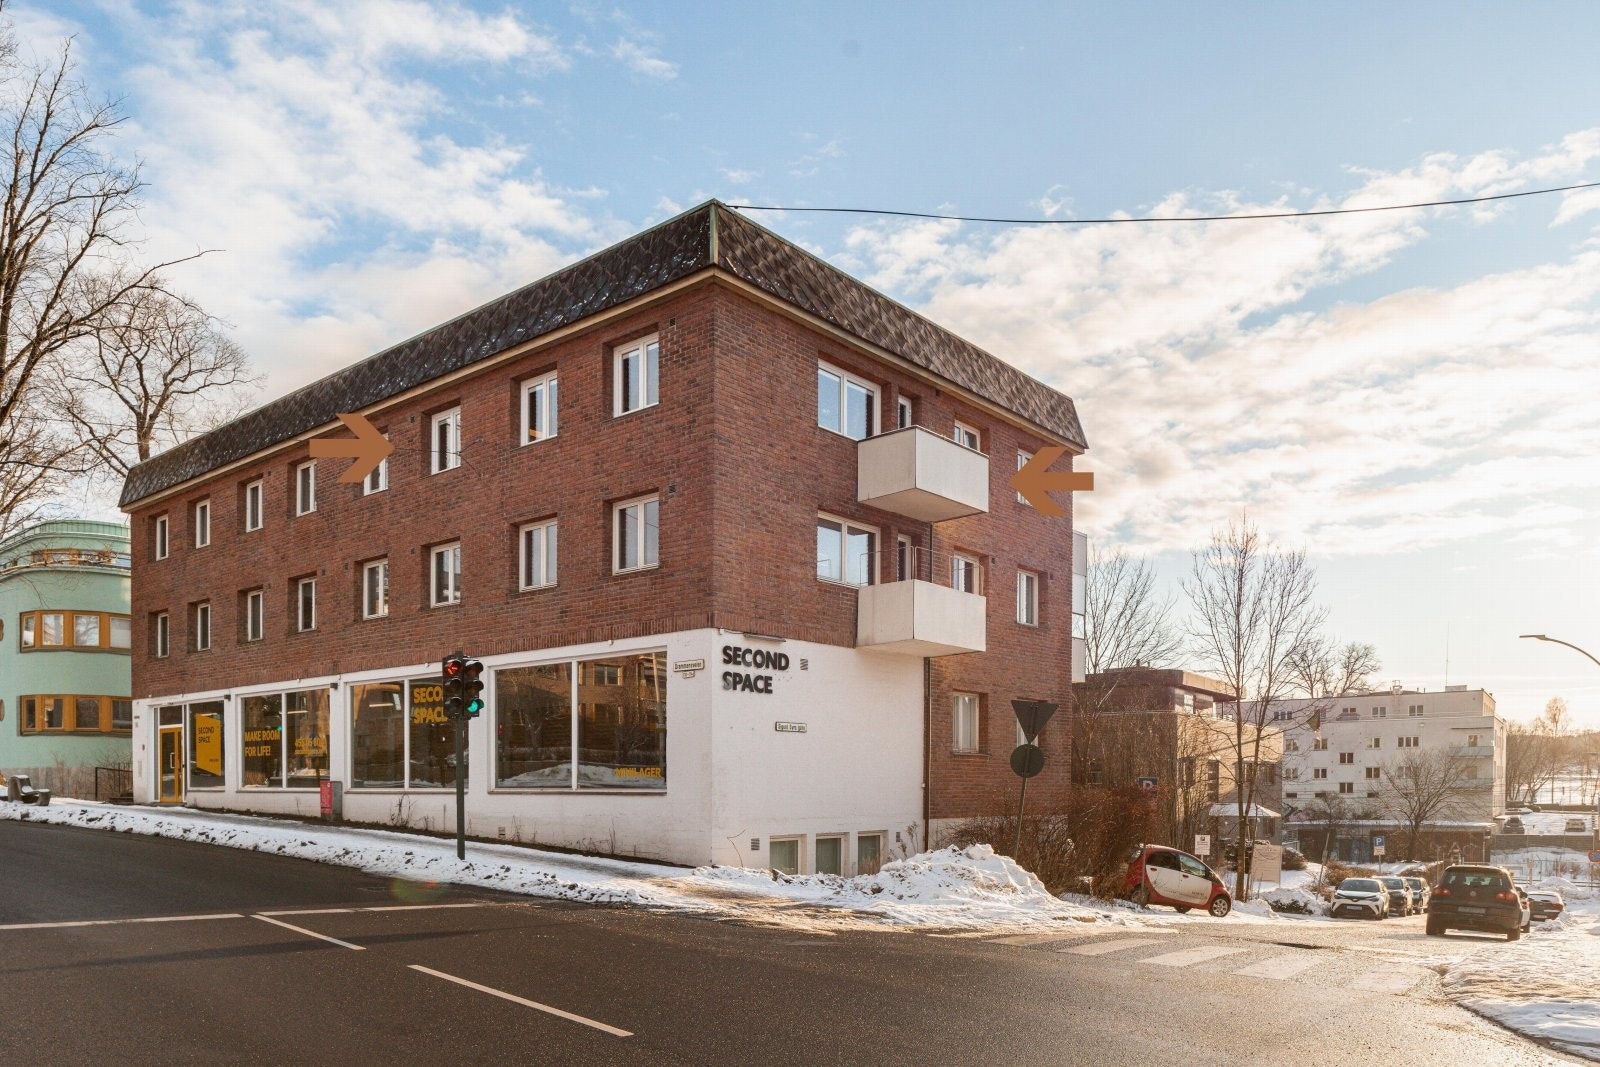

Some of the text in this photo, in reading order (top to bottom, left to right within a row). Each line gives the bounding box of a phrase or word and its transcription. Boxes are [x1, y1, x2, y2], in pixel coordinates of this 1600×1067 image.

[722, 645, 790, 671] SECOND
[722, 671, 773, 694] SPACE
[413, 686, 443, 704] SECO
[198, 726, 215, 735] SECOND
[244, 730, 280, 742] MAKE ROOM
[198, 736, 211, 744] SPACE
[244, 746, 256, 757] FOR
